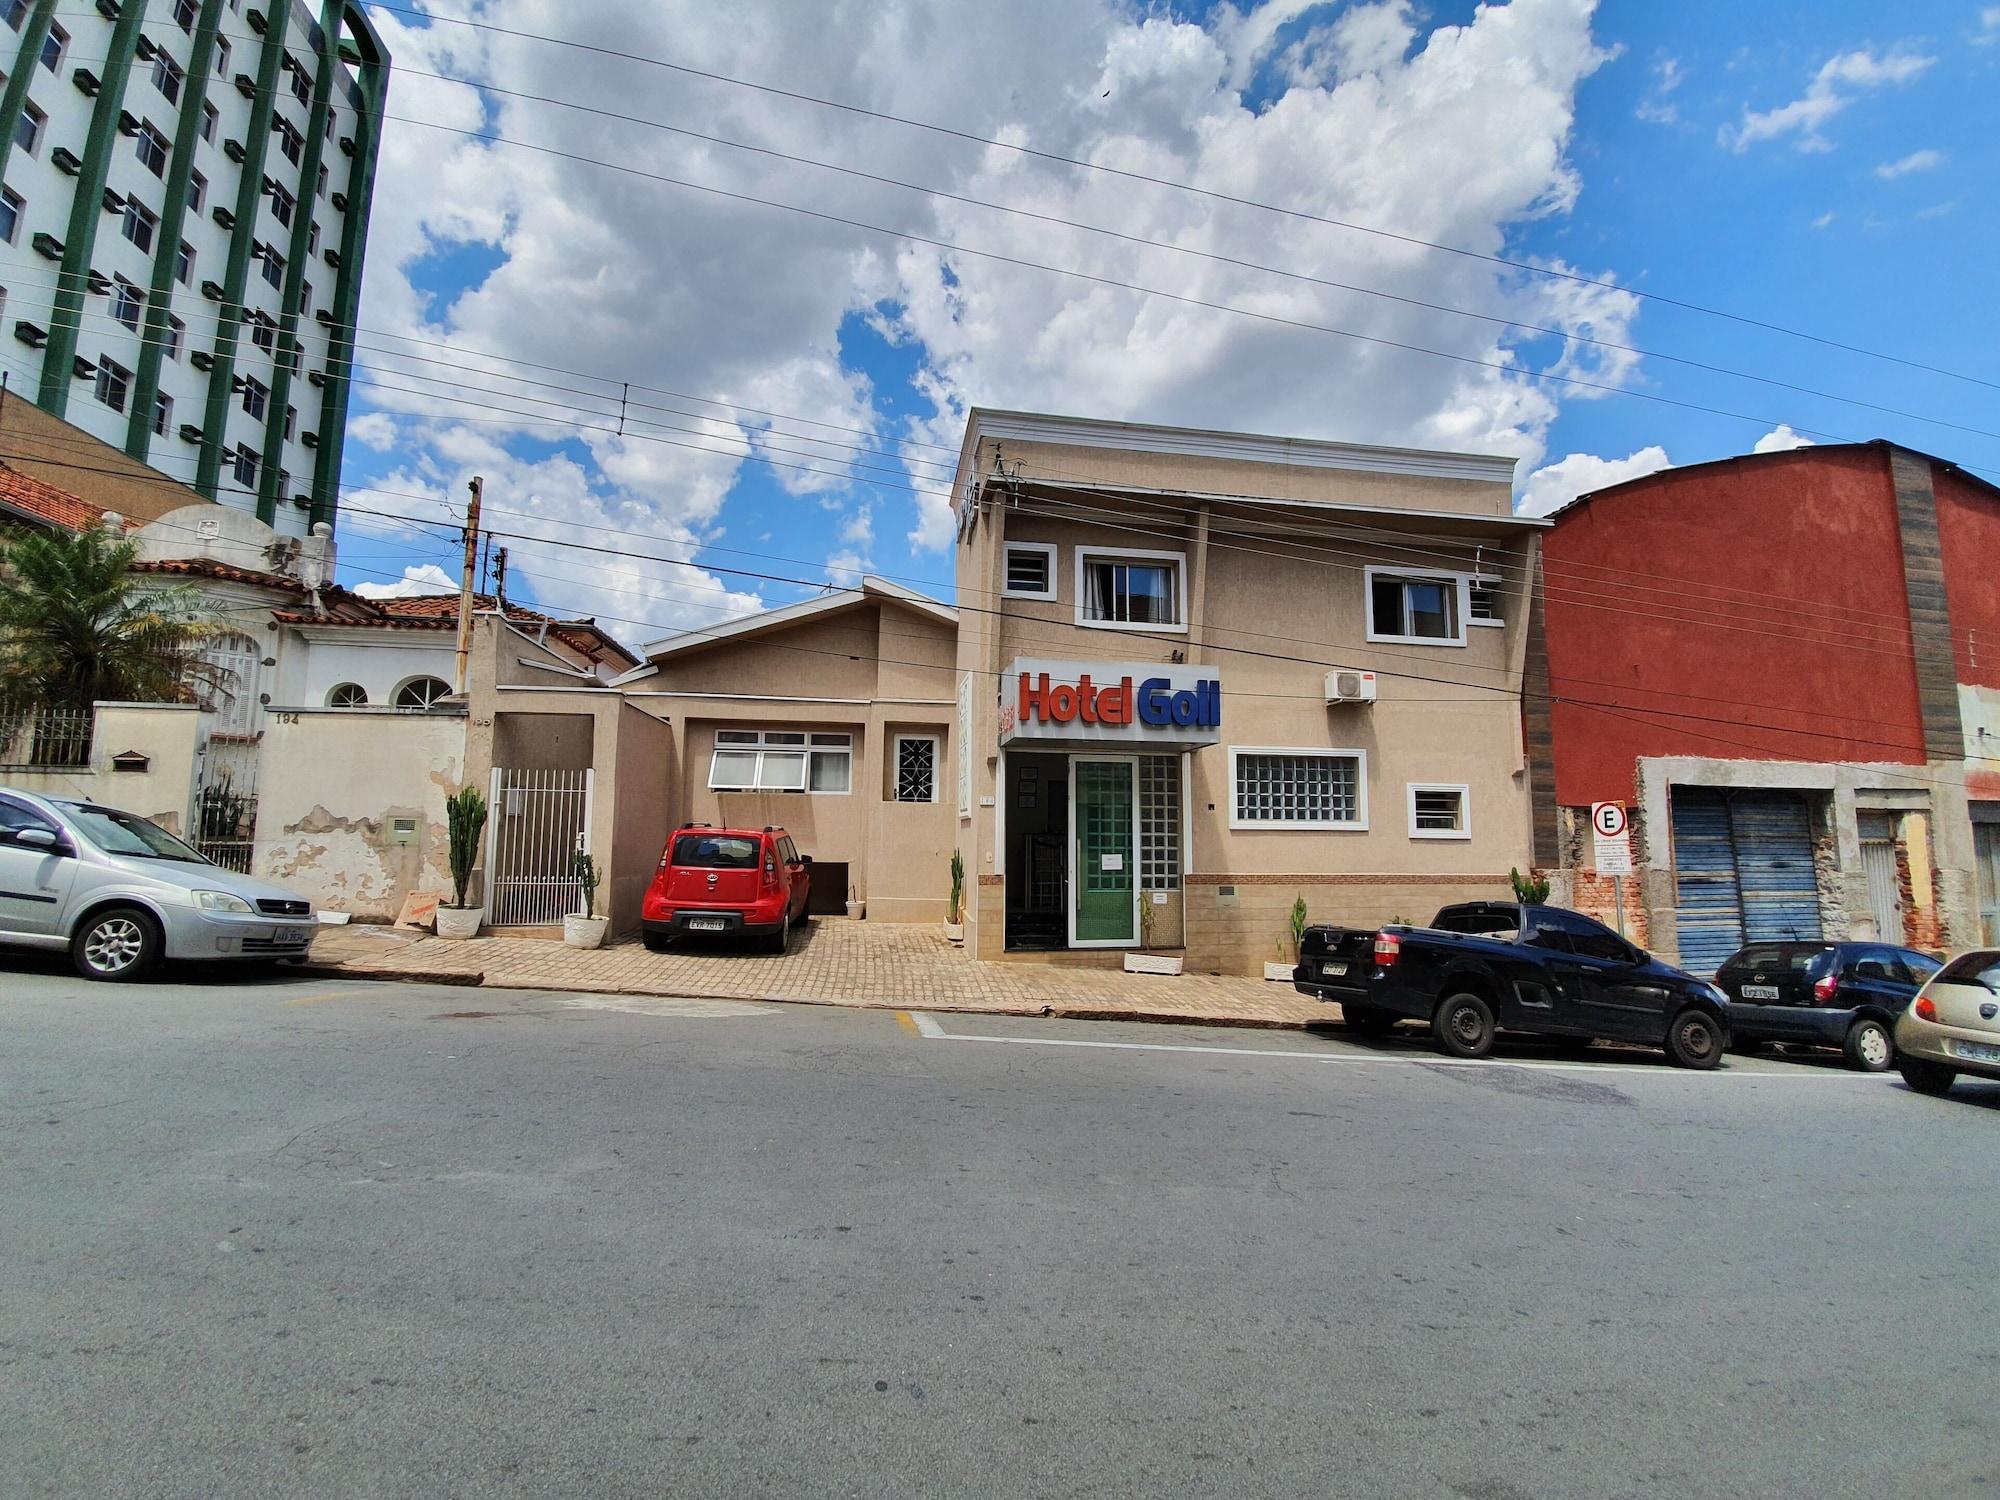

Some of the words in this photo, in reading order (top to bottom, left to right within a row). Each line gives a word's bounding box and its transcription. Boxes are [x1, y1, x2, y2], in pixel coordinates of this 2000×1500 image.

[1019, 672, 1132, 724] Hotel
[1138, 677, 1221, 727] Goll
[1604, 811, 1615, 829] E
